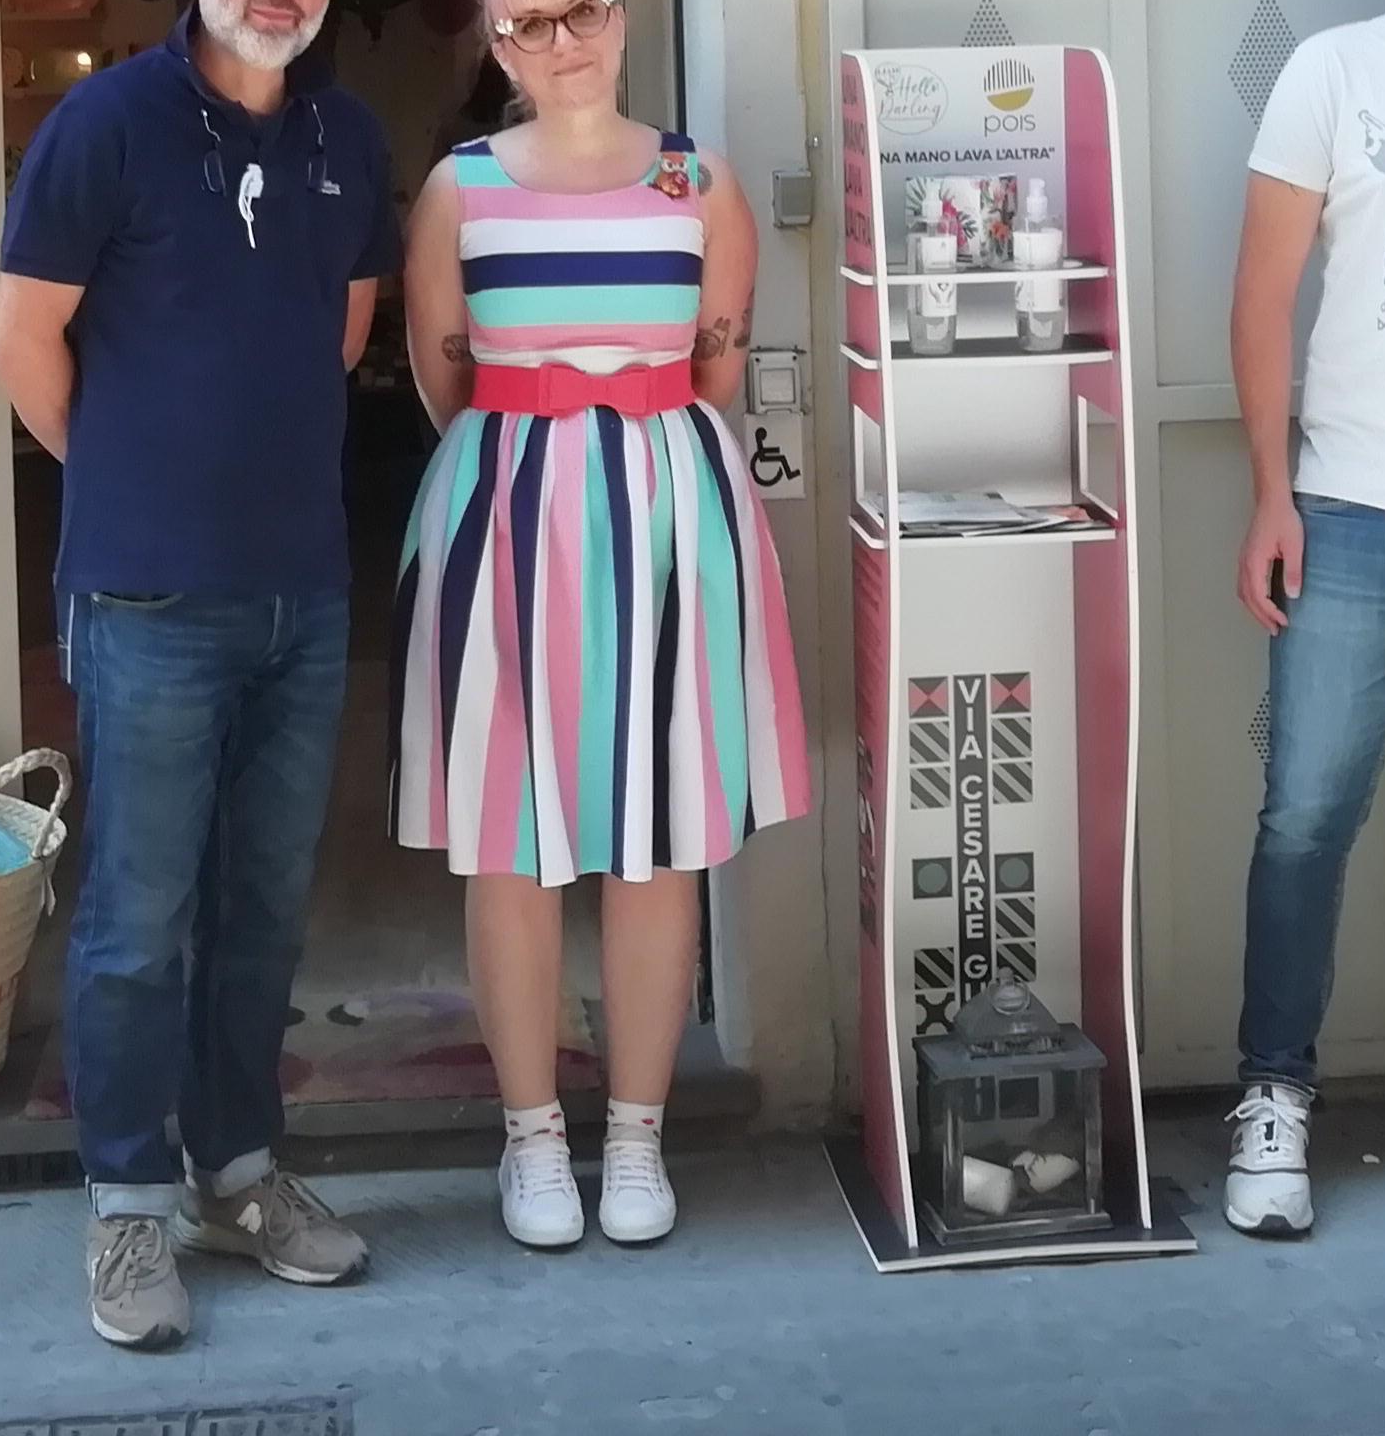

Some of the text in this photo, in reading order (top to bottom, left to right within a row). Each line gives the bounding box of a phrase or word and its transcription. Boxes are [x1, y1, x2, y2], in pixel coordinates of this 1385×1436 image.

[897, 76, 940, 101] Hello
[879, 95, 942, 125] Darling
[984, 115, 1036, 137] pois
[880, 152, 901, 164] NA
[905, 148, 951, 164] MANO
[955, 148, 993, 162] LAVA
[957, 678, 983, 760] VIA
[960, 774, 985, 940] CESARE
